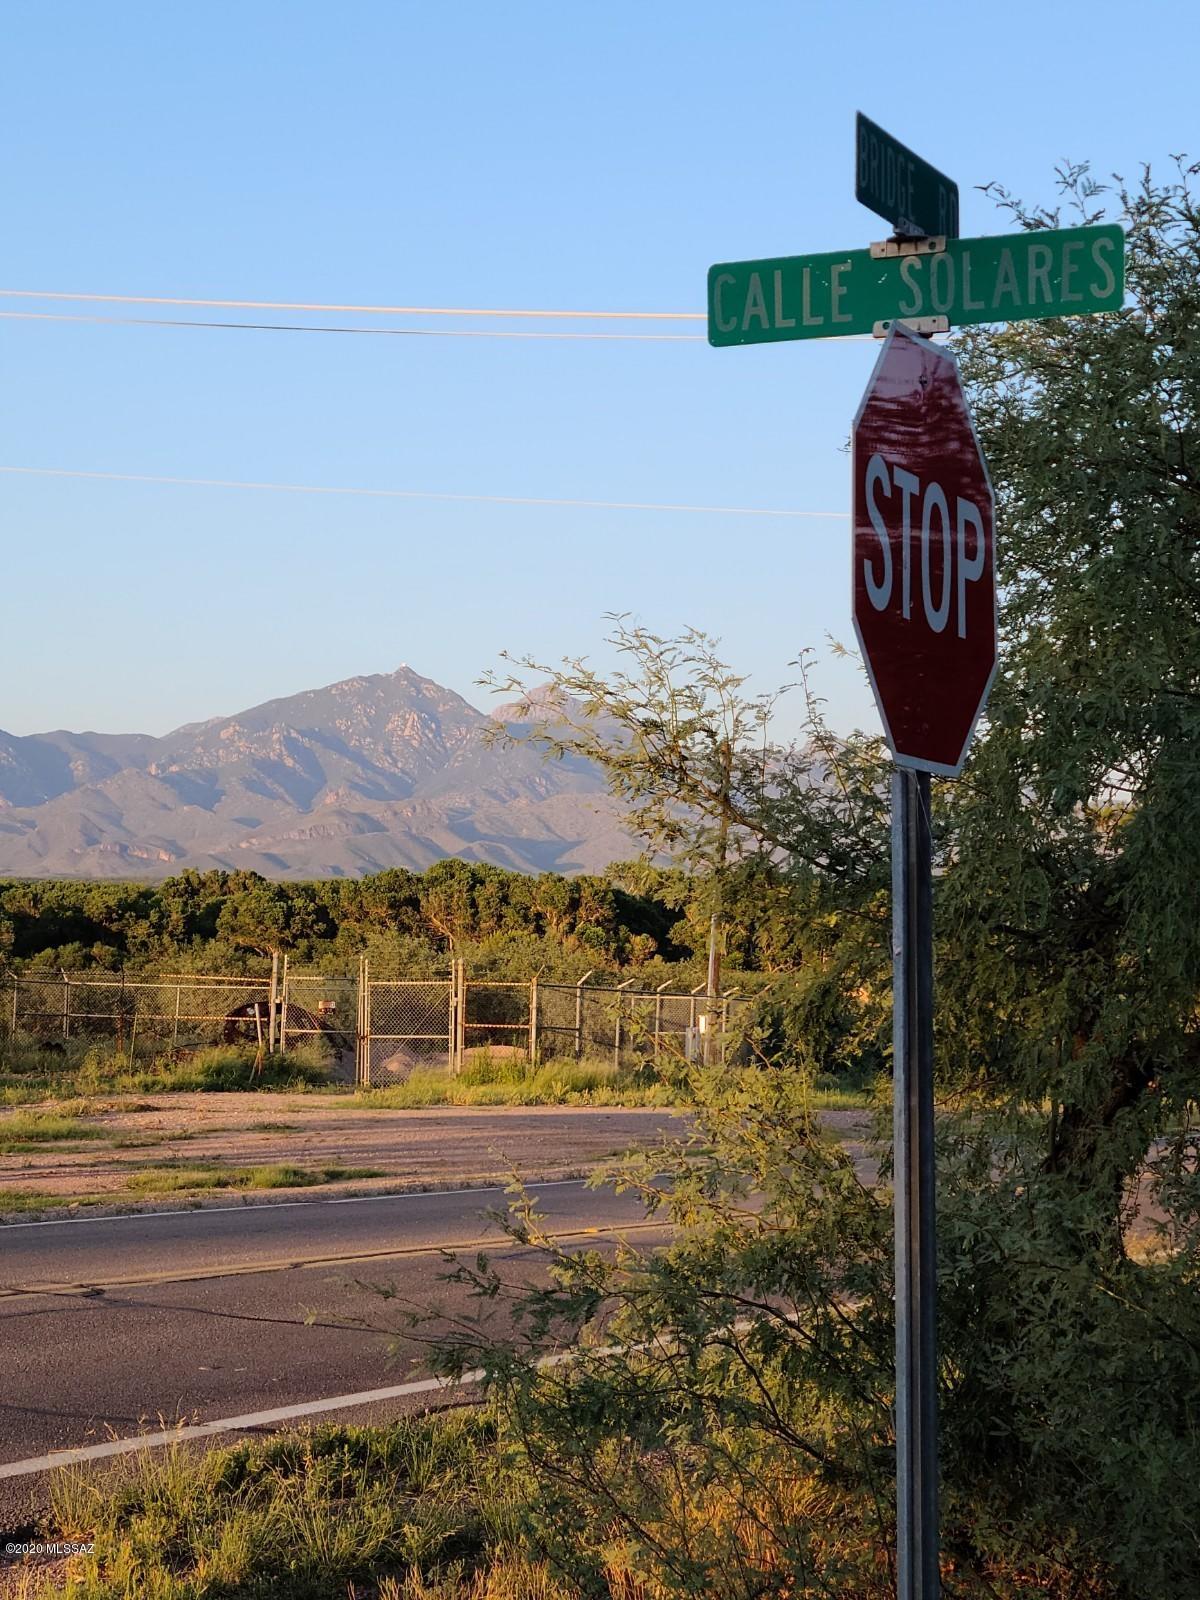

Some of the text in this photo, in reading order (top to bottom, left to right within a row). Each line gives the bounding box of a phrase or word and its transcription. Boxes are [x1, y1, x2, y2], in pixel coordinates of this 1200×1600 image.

[860, 125, 958, 238] BRIDGE RD
[713, 237, 1116, 332] CALLE SOLARES
[864, 453, 985, 639] STOP
